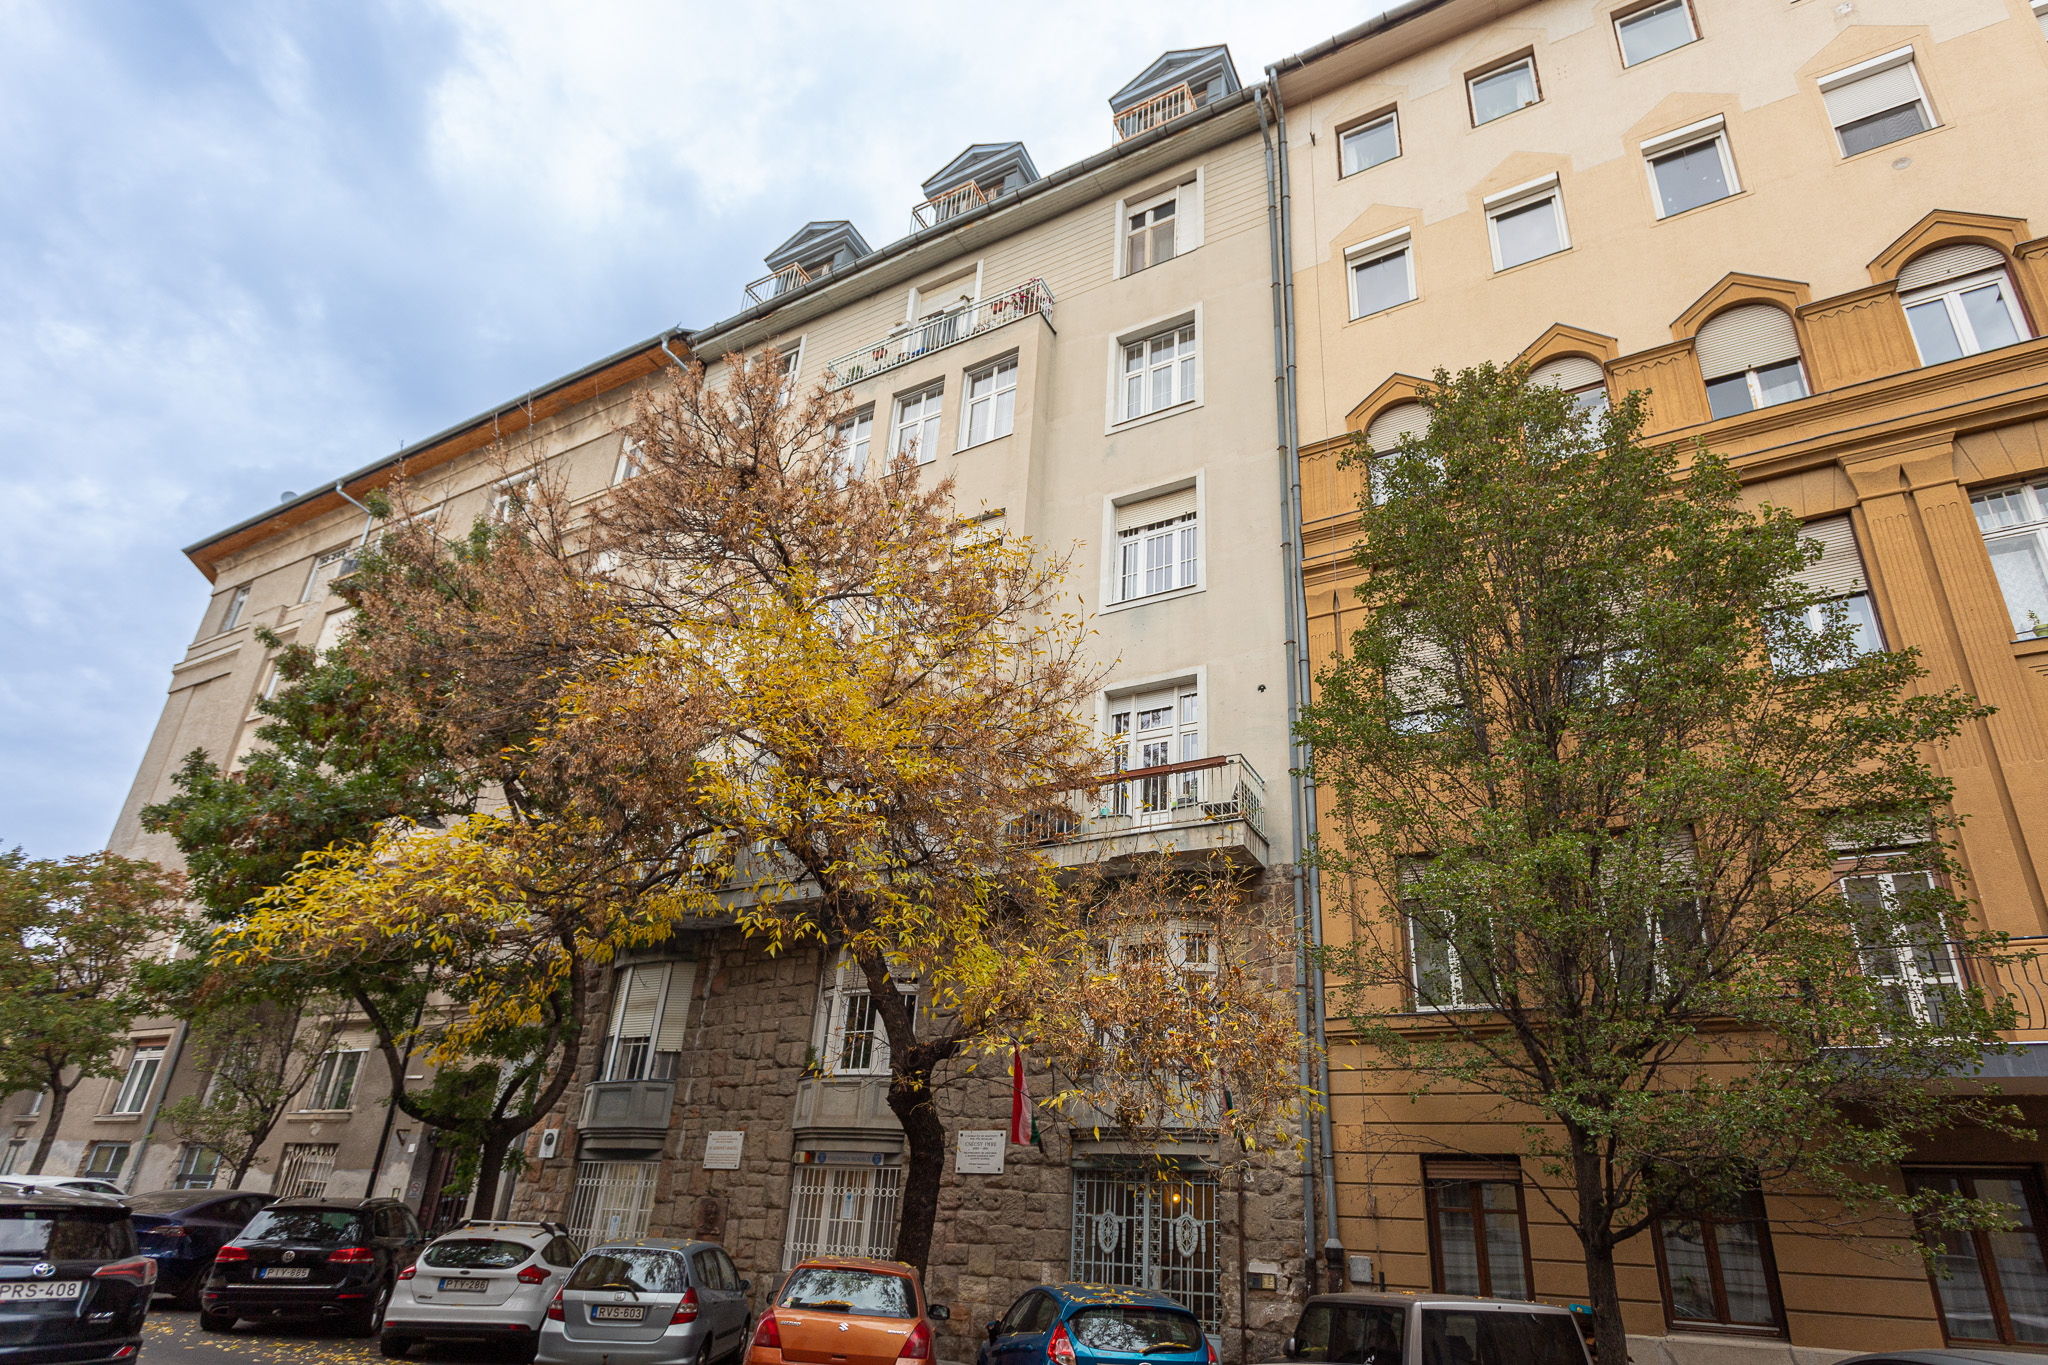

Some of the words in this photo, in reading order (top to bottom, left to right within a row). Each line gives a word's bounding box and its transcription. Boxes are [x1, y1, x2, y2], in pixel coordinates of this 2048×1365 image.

[0, 1283, 77, 1298] PRS-408
[445, 1279, 487, 1290] PTY-286
[598, 1307, 642, 1319] RVS-603
